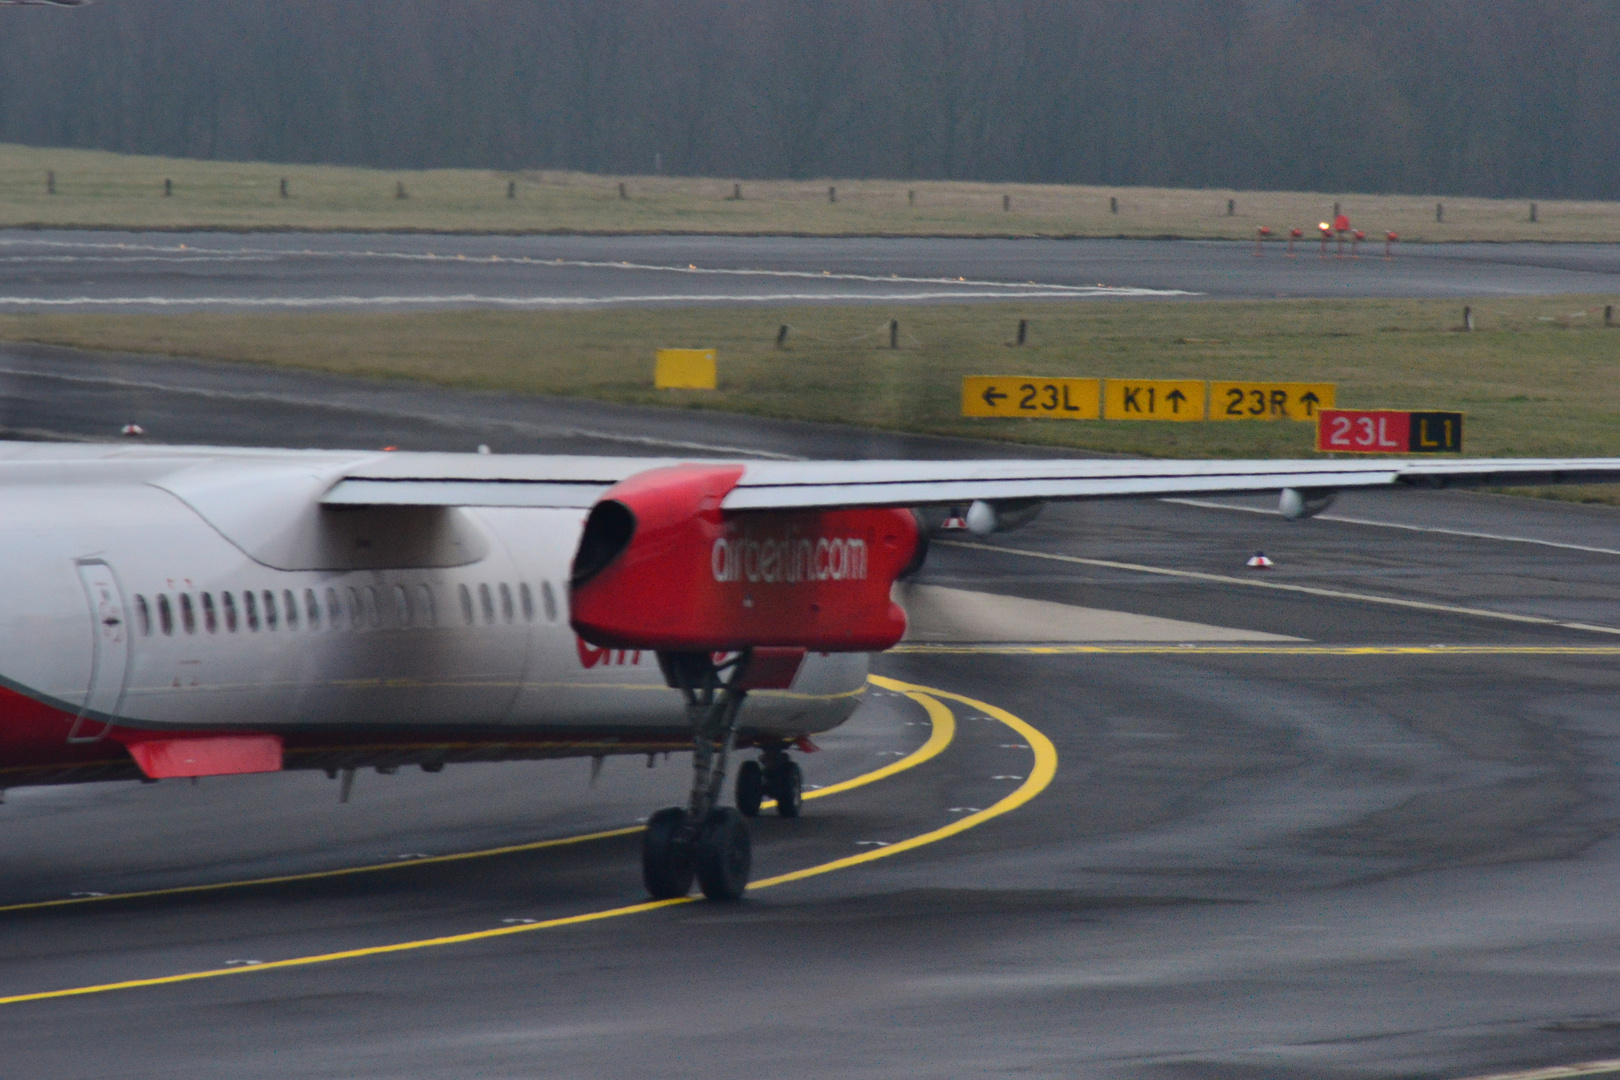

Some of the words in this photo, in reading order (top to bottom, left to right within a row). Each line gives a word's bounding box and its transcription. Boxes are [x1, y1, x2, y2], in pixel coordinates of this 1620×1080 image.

[1019, 384, 1079, 411] 23L
[1124, 387, 1156, 413] K1
[1226, 388, 1288, 415] 23R
[1331, 417, 1397, 447] 23L
[1421, 418, 1453, 447] L1
[713, 537, 867, 582] airberlin.com
